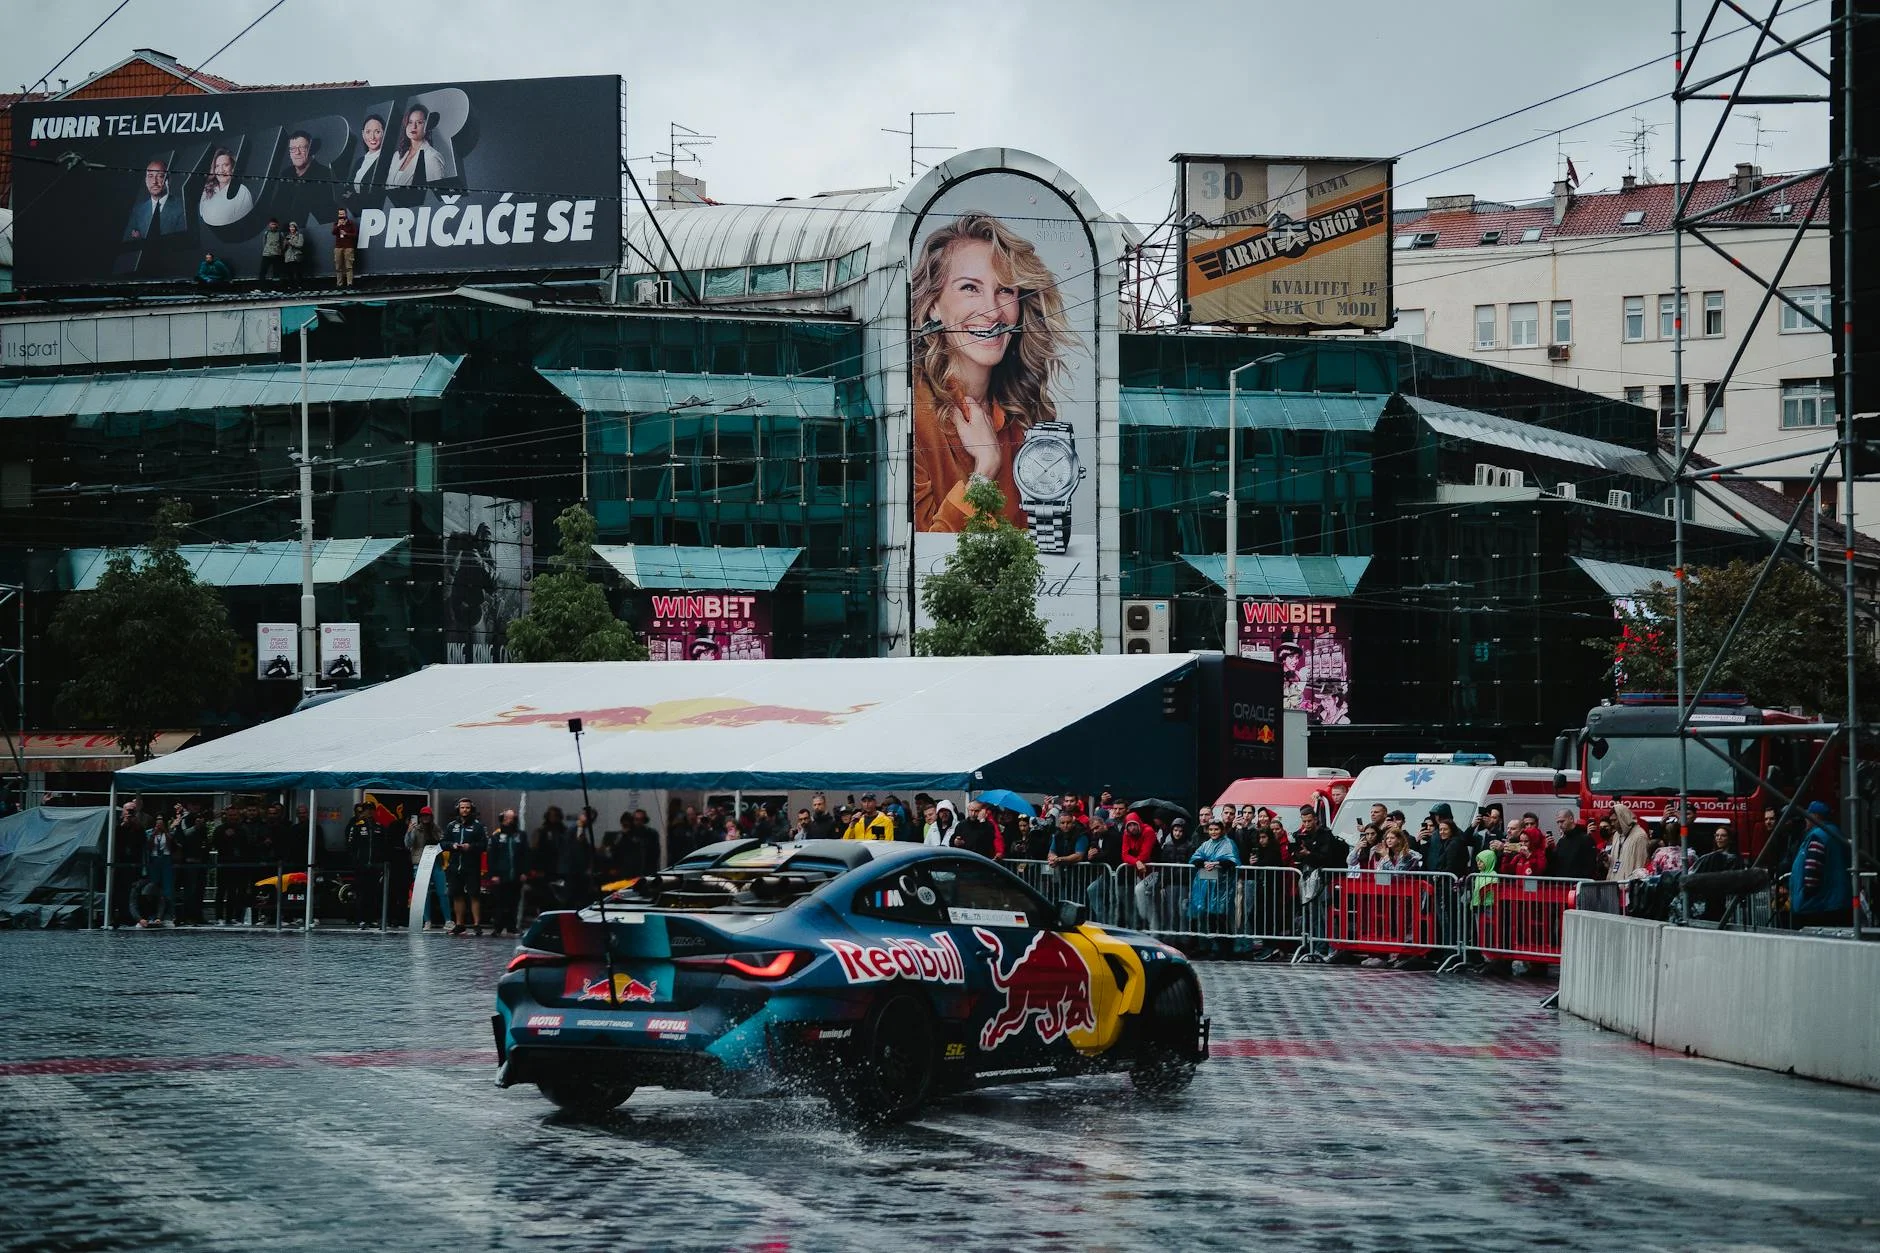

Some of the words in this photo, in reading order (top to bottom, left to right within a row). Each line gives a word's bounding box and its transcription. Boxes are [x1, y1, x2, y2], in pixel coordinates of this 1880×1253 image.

[31, 115, 101, 140] KURIR
[105, 111, 225, 136] TELEVIZIJA
[1201, 170, 1244, 201] 30
[1305, 174, 1350, 200] VAMA
[356, 192, 538, 249] PRIČAĆE
[543, 199, 597, 243] SE
[1223, 236, 1277, 272] ARMY
[1308, 206, 1360, 243] SHOP
[1271, 280, 1350, 296] KVALITET
[1361, 281, 1378, 297] JE
[1264, 299, 1305, 315] UVEK
[1316, 300, 1325, 315] U
[1336, 302, 1377, 317] MODI
[652, 595, 756, 619] WINBET
[1242, 602, 1337, 624] WINBET
[447, 642, 466, 664] KING
[472, 643, 494, 664] KONG
[1233, 702, 1276, 722] ORACLE
[820, 937, 921, 984] Red
[896, 931, 965, 984] Bull
[528, 1015, 561, 1026] MOTUL
[647, 1019, 687, 1031] MOTUL
